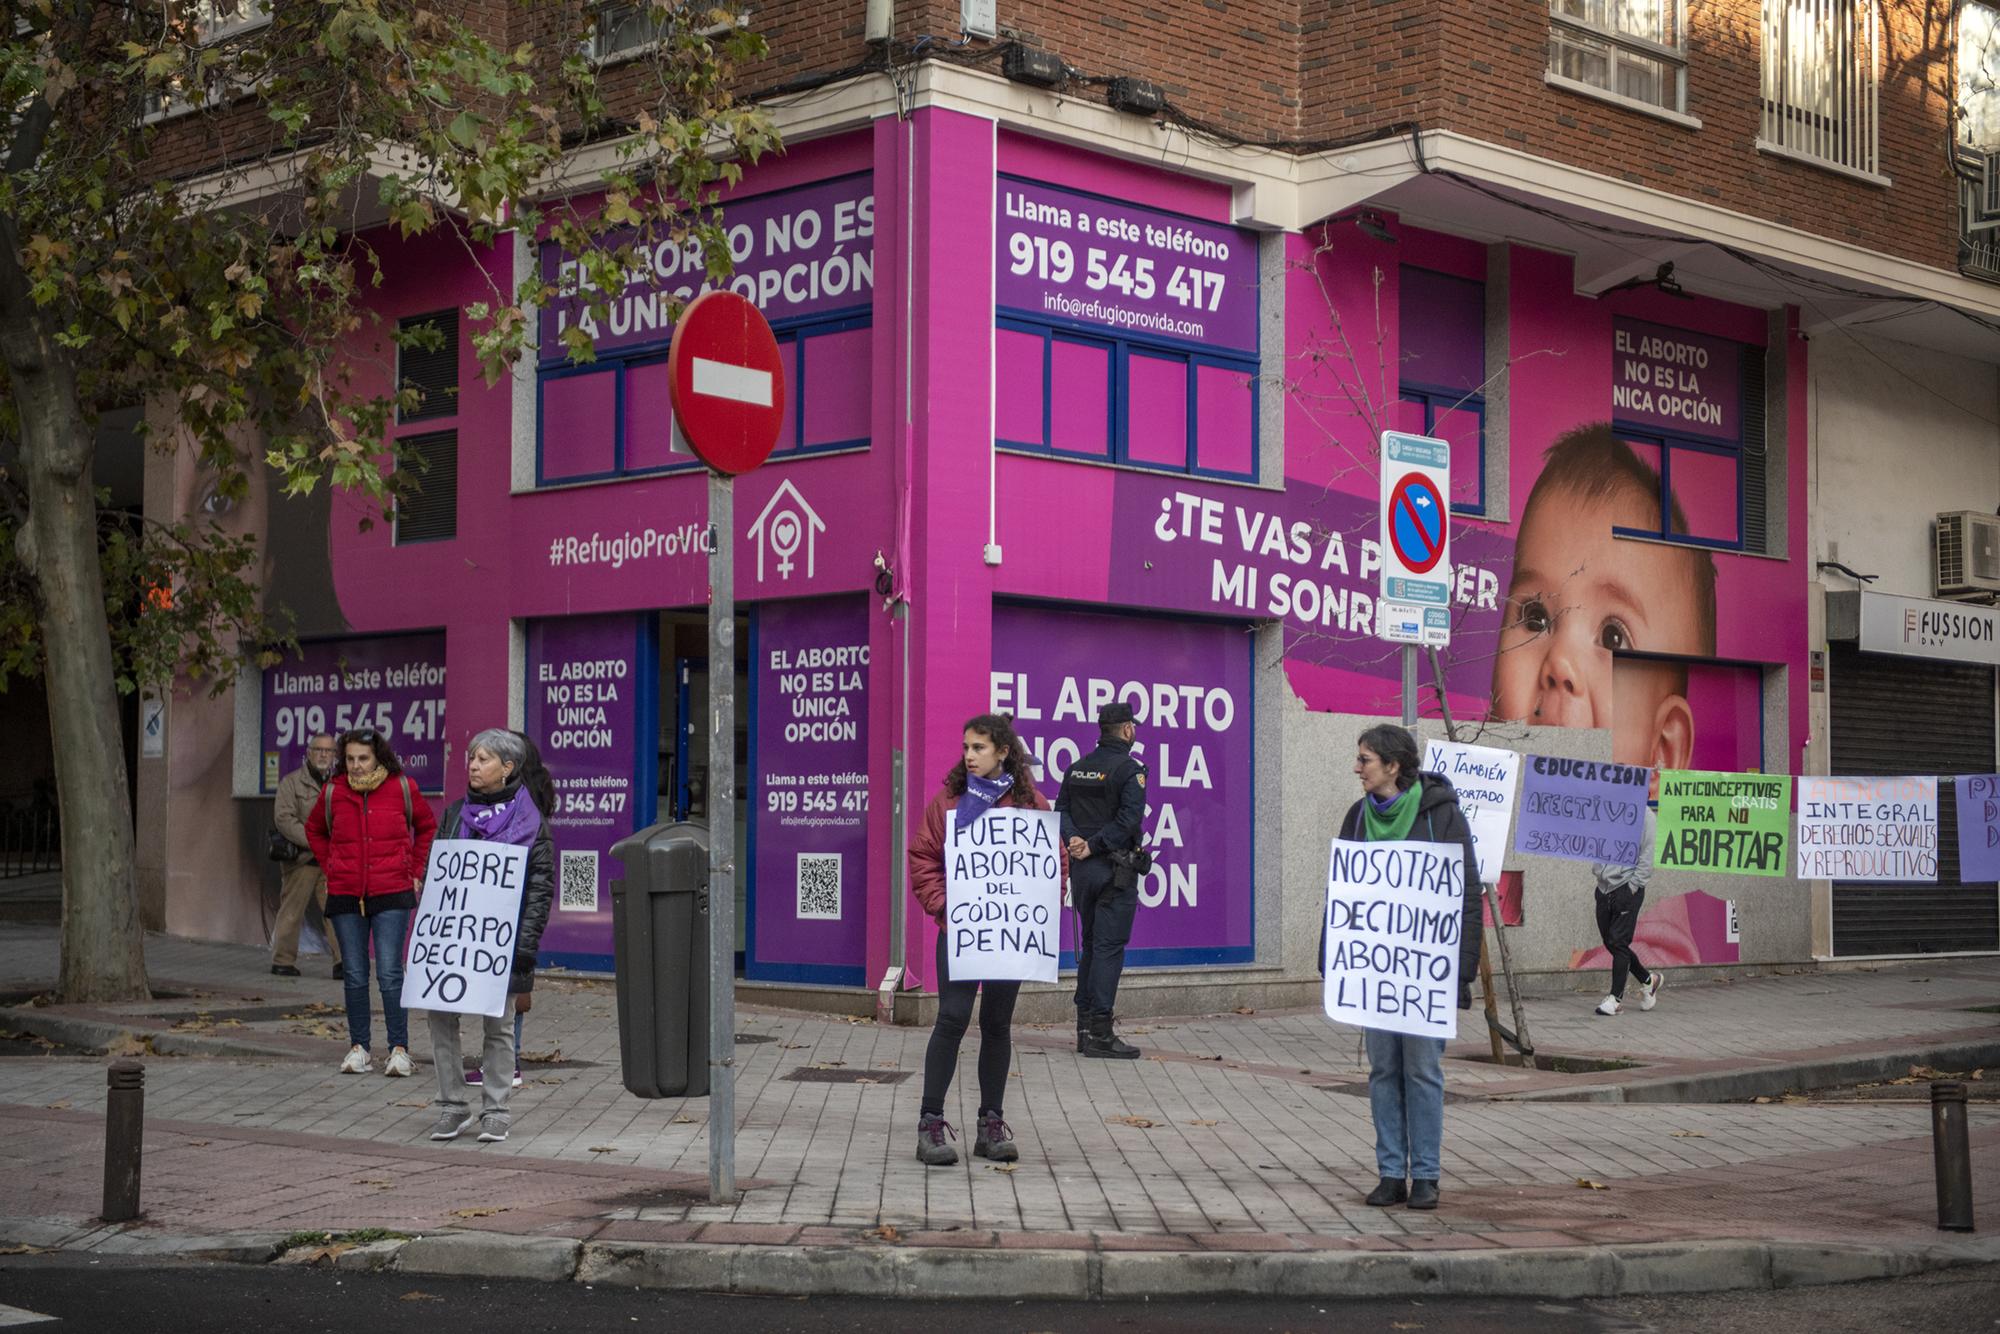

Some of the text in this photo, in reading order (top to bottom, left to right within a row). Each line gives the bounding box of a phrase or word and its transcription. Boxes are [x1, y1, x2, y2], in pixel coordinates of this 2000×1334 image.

[766, 209, 821, 256] NO
[834, 196, 874, 242] ES
[1006, 192, 1229, 261] Llama a este teléfono
[729, 244, 874, 308] OPCIÓN
[1009, 232, 1226, 312] 919 545 417
[1044, 292, 1204, 337] info@refugioprovida.com
[1615, 330, 1708, 368] EL ABORTO
[1625, 360, 1700, 394] NO ES LA
[1613, 385, 1721, 425] NICA OPCIÓN
[550, 522, 710, 568] #RefugioProVid
[1155, 491, 1224, 545] ¿TE
[1235, 506, 1312, 565] VAS
[1321, 531, 1349, 575] A
[1211, 559, 1257, 609] MI
[1922, 611, 1993, 641] FUSSION
[1921, 637, 1944, 647] DAY
[539, 659, 627, 681] EL ABORTO
[771, 650, 791, 670] EL
[274, 672, 324, 694] Llama
[329, 674, 339, 691] a
[344, 668, 381, 690] este
[547, 683, 617, 703] NO ES LA
[780, 671, 863, 694] NO ES LA
[557, 704, 606, 725] ÚNICA
[792, 695, 850, 718] ÚNICA
[990, 671, 1234, 732] EL ABORTO
[275, 705, 326, 747] 919
[551, 725, 611, 748] OPCIÓN
[785, 719, 857, 743] OPCIÓN
[766, 773, 796, 785] Llama
[798, 775, 805, 785] a
[807, 774, 829, 785] este
[1159, 743, 1213, 789] LA
[570, 778, 589, 788] este
[591, 776, 628, 788] teléfono
[1455, 788, 1504, 803] BORTADO
[1664, 782, 1782, 798] ANTICONCEPTIVOS
[565, 793, 595, 812] 545
[599, 793, 626, 812] 417
[768, 791, 798, 812] 919
[802, 790, 837, 812] 545
[1527, 791, 1637, 825] AFECTIVO
[1681, 806, 1749, 824] PARA NO
[1731, 796, 1778, 810] GRATIS
[1806, 803, 1935, 822] INTEGRAL
[780, 816, 860, 827] info@refugioprovida.com
[954, 816, 1052, 849] FUERA
[1801, 824, 1936, 849] DERECHOS SEXUALES
[1525, 831, 1638, 865] SEXUAL YA
[1660, 828, 1783, 870] ABORTAR
[434, 850, 518, 889] SOBRE
[954, 851, 1057, 880] ABORTO
[1332, 848, 1463, 897] NOSOTRAS
[1800, 850, 1937, 877] Y REPRODUCTIVOS
[439, 885, 467, 911] MI
[986, 882, 1021, 895] DEL
[951, 896, 1048, 925] CÓDIGO
[1330, 900, 1460, 945] DECIDIMOS
[416, 914, 513, 947] CUERPO
[956, 927, 1056, 958] PENAL
[412, 942, 508, 976] DECIDO
[1332, 940, 1450, 981] ABORTO
[422, 967, 467, 1003] YO
[1338, 976, 1448, 1025] LIBRE
